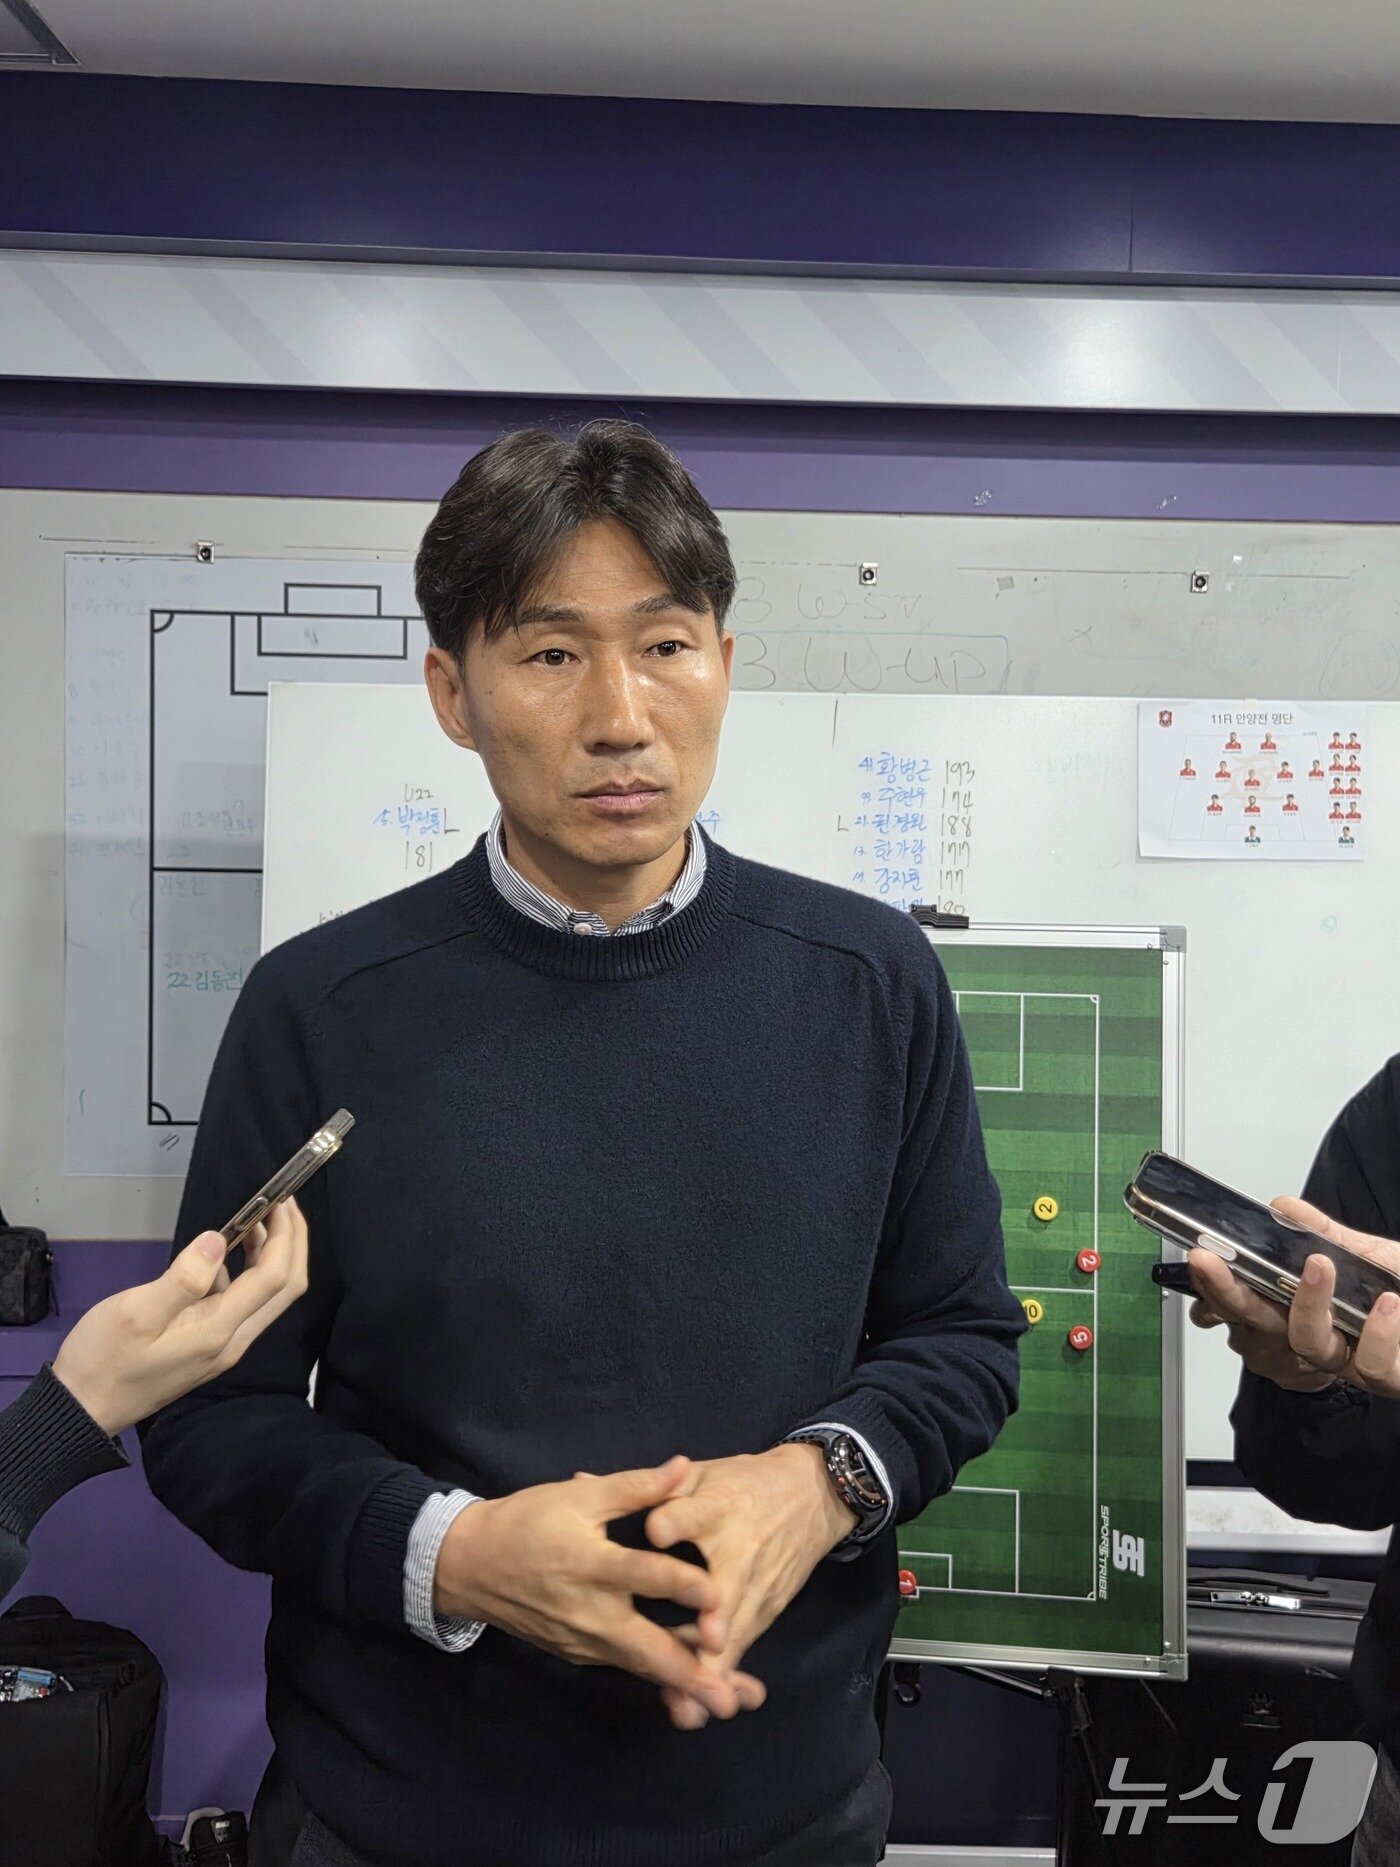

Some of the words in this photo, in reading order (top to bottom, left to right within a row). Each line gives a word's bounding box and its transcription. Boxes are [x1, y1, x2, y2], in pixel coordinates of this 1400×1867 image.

[1210, 712, 1233, 725] 11R
[1235, 712, 1268, 726] 안양전
[1271, 712, 1294, 726] 명단
[945, 759, 976, 786] 193
[941, 787, 974, 814] 174
[940, 813, 973, 838] 188
[405, 840, 433, 873] 181
[939, 868, 964, 895] 177
[166, 971, 192, 989] 22
